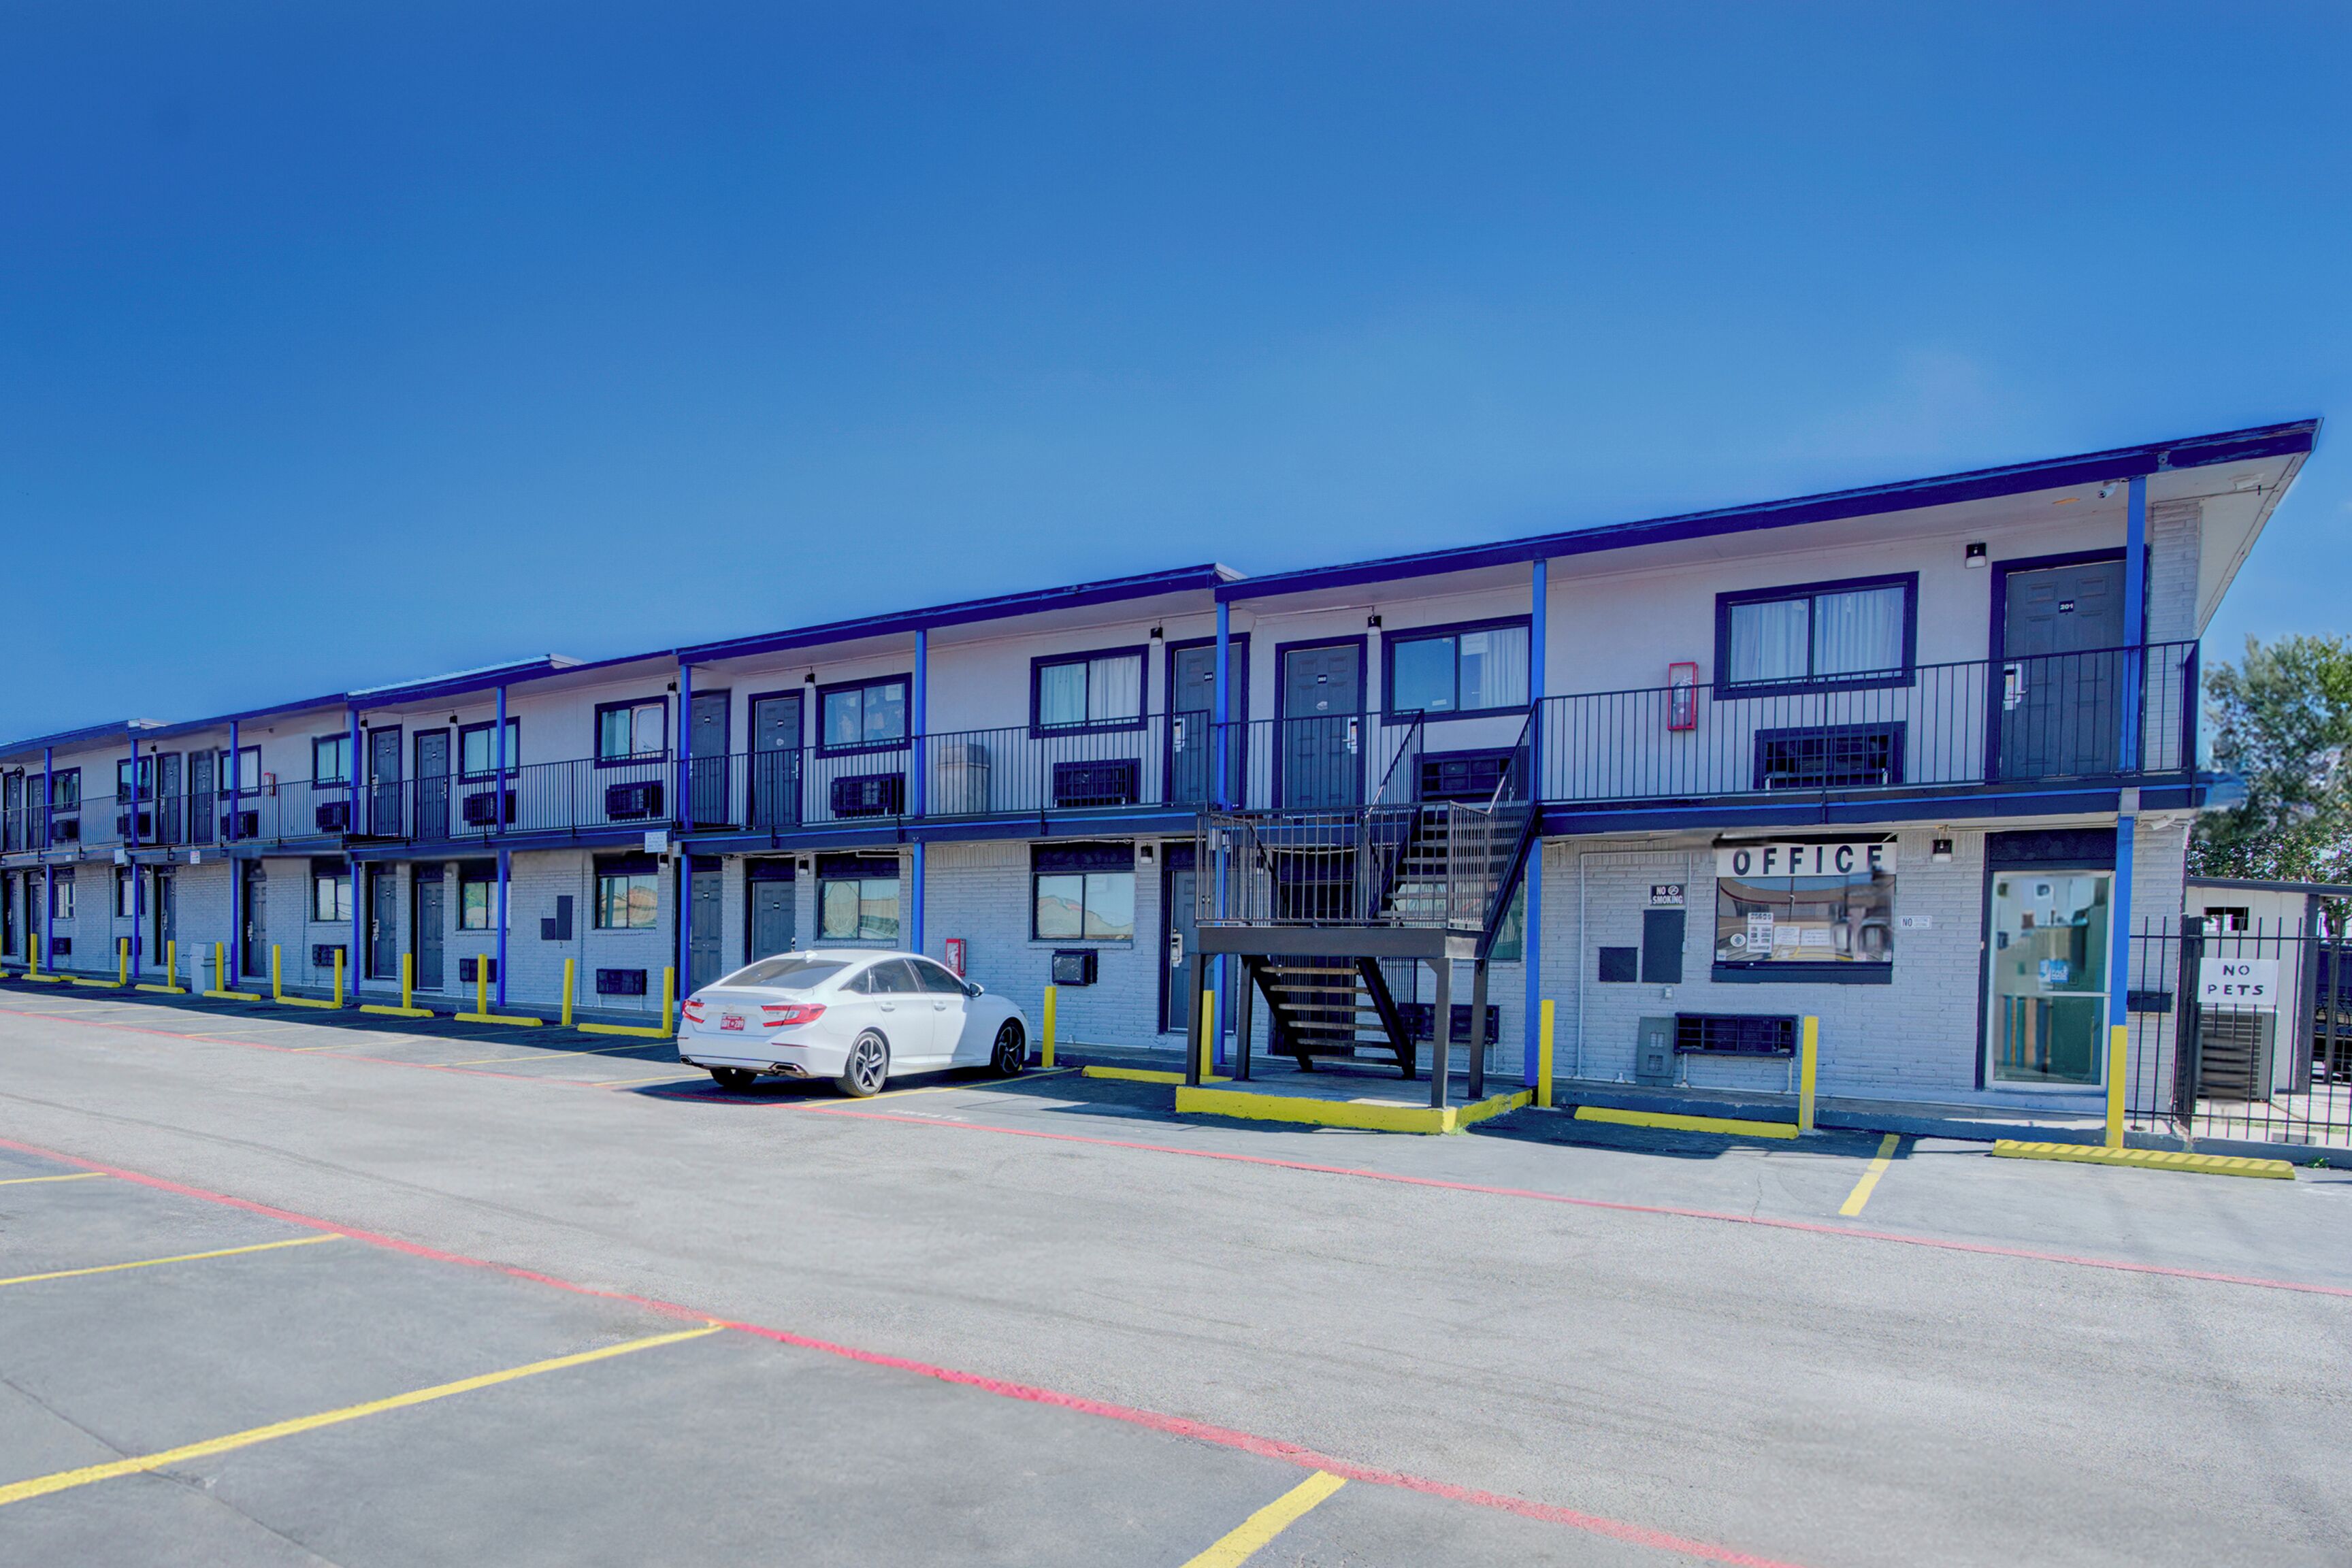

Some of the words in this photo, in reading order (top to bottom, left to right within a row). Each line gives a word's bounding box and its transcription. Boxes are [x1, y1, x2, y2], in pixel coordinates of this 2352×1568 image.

[1733, 845, 1883, 876] OFFICE
[1656, 886, 1666, 895] NO
[1652, 895, 1683, 904] SMOKING
[1903, 918, 1912, 926] NO
[2223, 965, 2249, 976] NO
[2208, 984, 2264, 995] PETS
